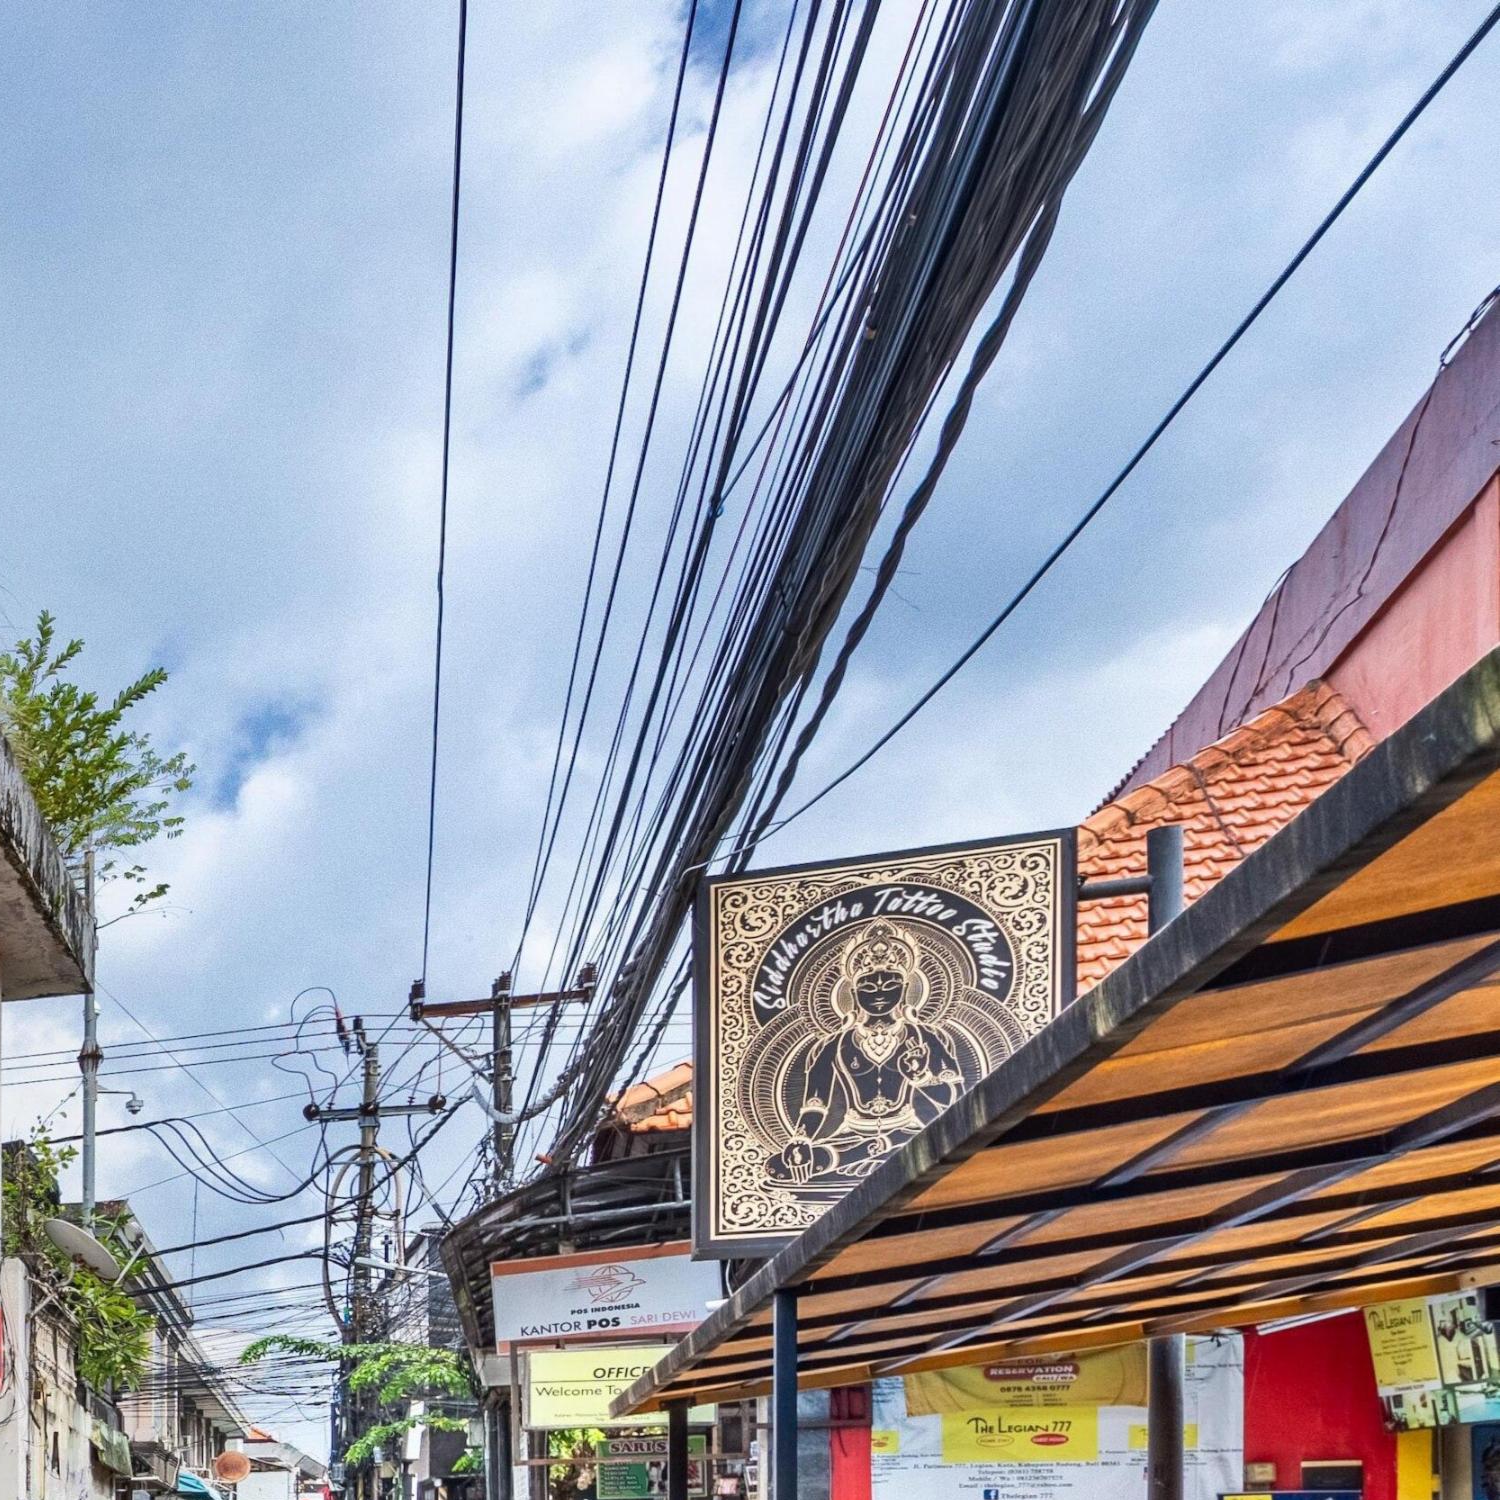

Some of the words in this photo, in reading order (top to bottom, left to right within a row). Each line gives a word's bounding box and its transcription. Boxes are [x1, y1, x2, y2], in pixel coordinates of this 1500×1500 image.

[873, 886, 957, 921] Tattoo
[952, 917, 1000, 992] Studio
[570, 1308, 588, 1316] POS
[590, 1302, 641, 1313] INDONESIA
[520, 1320, 582, 1337] KANTOR
[586, 1317, 621, 1330] POS
[630, 1313, 659, 1326] SARI
[662, 1310, 697, 1323] DEWI
[989, 1364, 1075, 1377] RESERVATION
[535, 1386, 603, 1397] Welcome
[606, 1385, 622, 1396] To
[1051, 1421, 1073, 1432] 777
[609, 1441, 653, 1454] SARI
